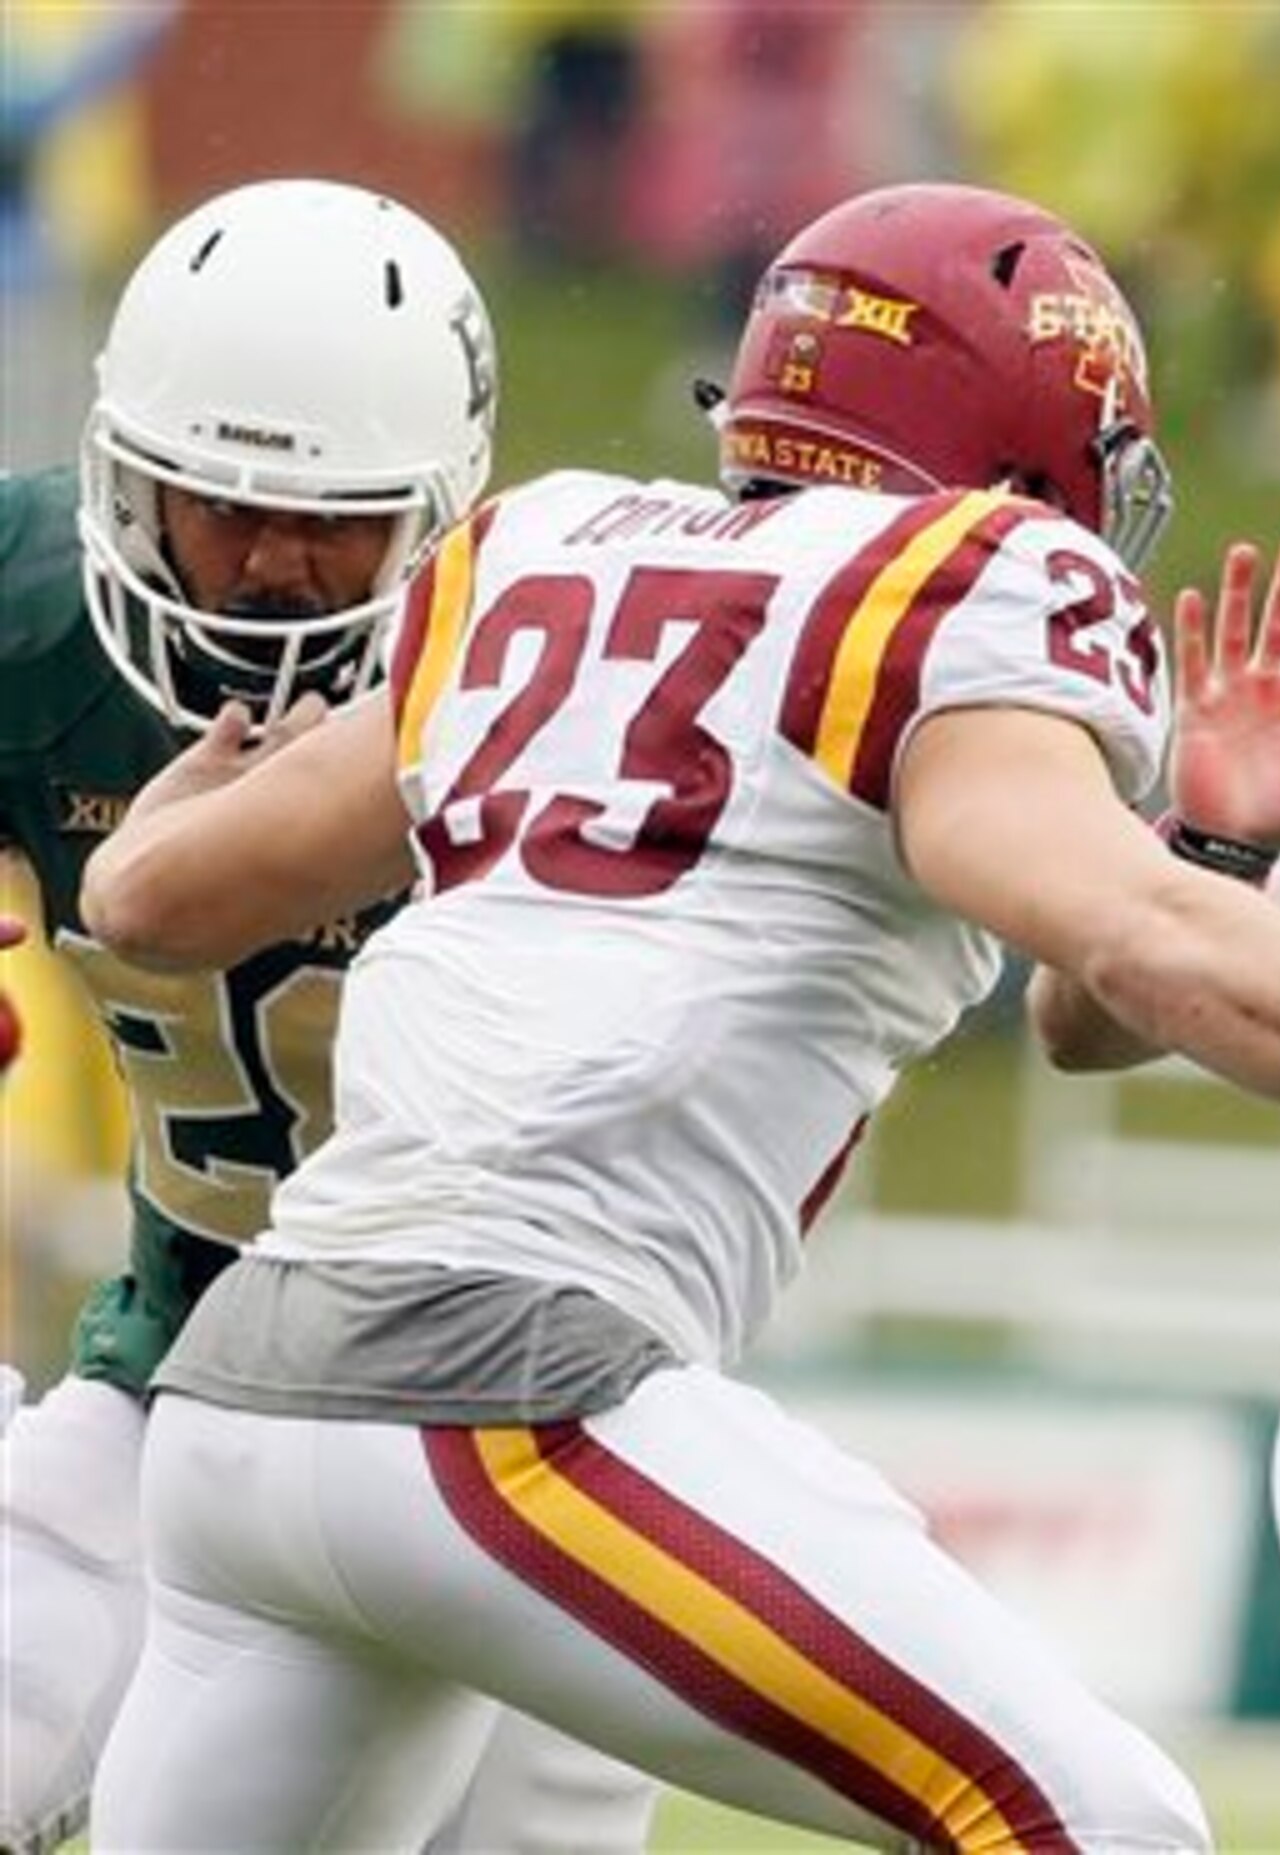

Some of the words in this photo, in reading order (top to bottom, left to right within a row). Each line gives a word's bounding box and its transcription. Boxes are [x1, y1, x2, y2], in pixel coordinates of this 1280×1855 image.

[834, 287, 919, 348] XII
[780, 364, 812, 393] 23
[773, 438, 883, 491] STATE
[1045, 549, 1157, 717] 23
[413, 565, 784, 898] 23
